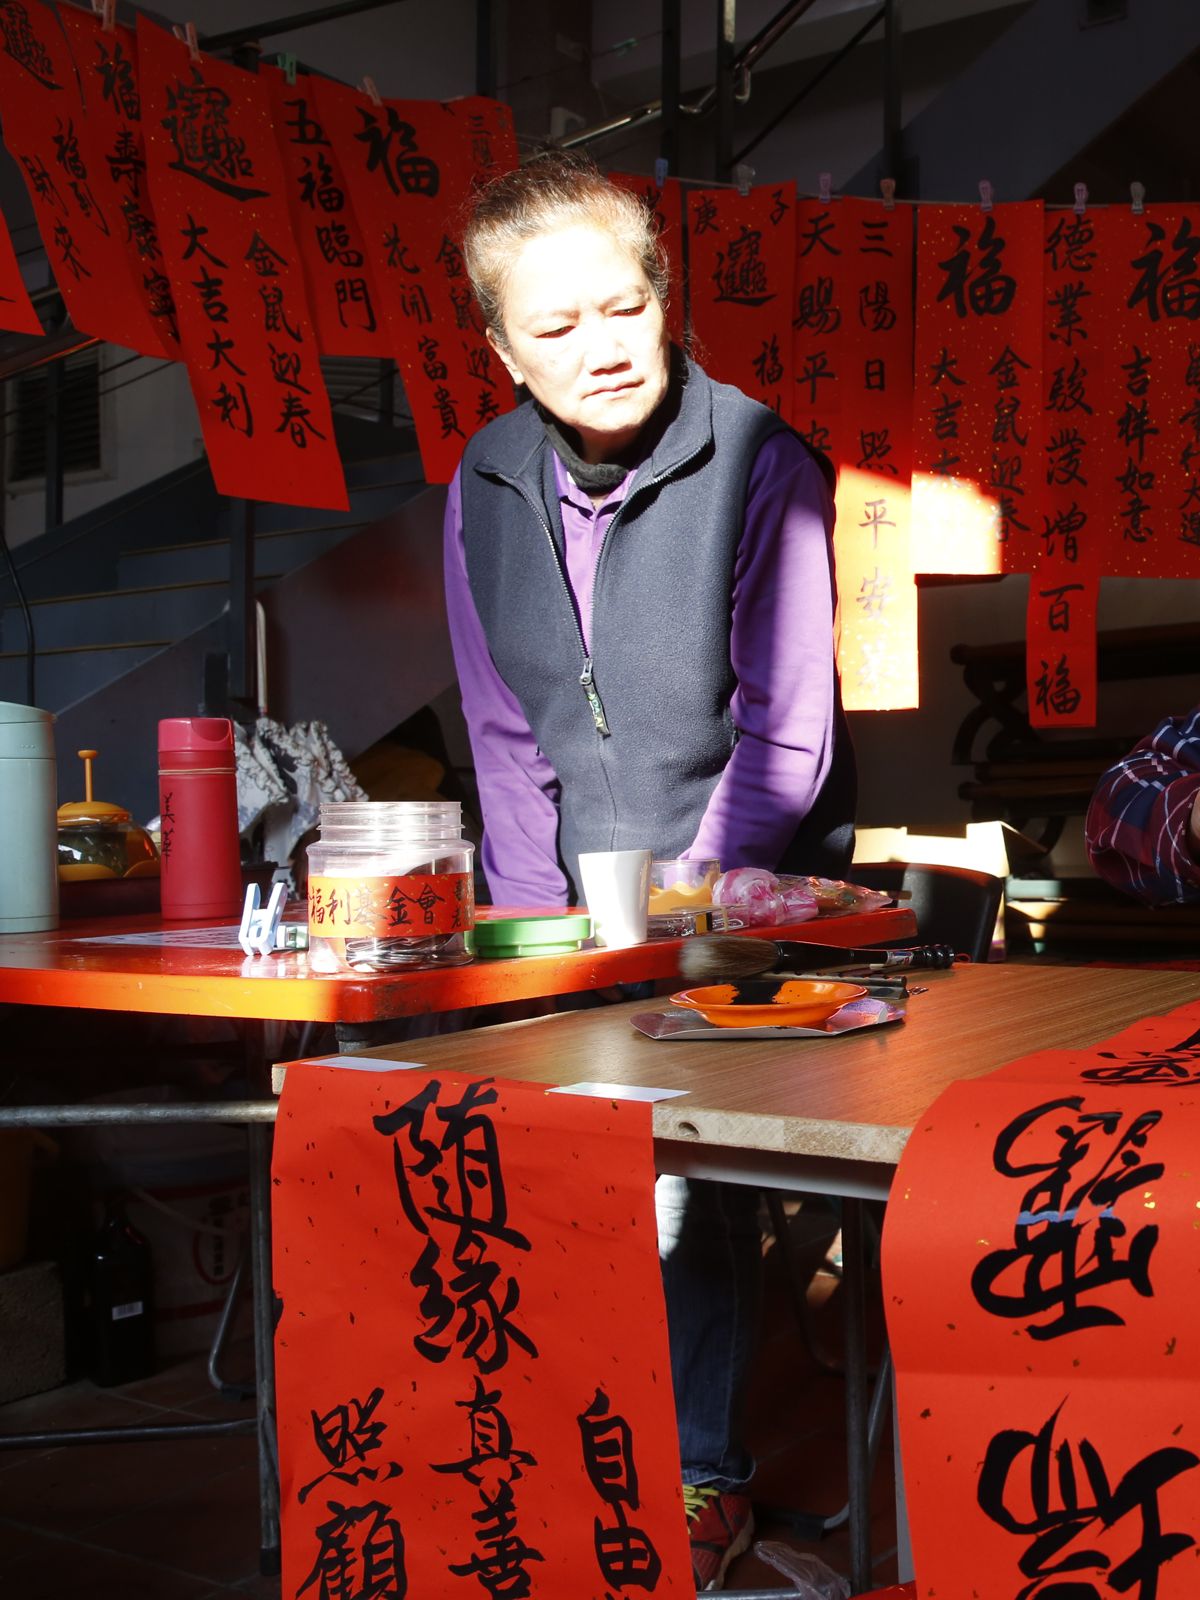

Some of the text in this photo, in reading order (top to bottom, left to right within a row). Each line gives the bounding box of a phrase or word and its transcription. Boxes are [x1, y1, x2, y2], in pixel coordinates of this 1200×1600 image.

[283, 98, 377, 334] 五福臨門
[354, 105, 440, 198] 福
[178, 213, 253, 439] 大吉大利
[243, 231, 328, 449] 金鼠迎春
[383, 223, 467, 440] 花開富貴
[937, 216, 1017, 318] 福
[854, 219, 898, 692] 三陽日照平安
[988, 345, 1033, 542] 金鼠迎春
[1115, 345, 1160, 544] 吉祥如意
[576, 1389, 662, 1592] 自由
